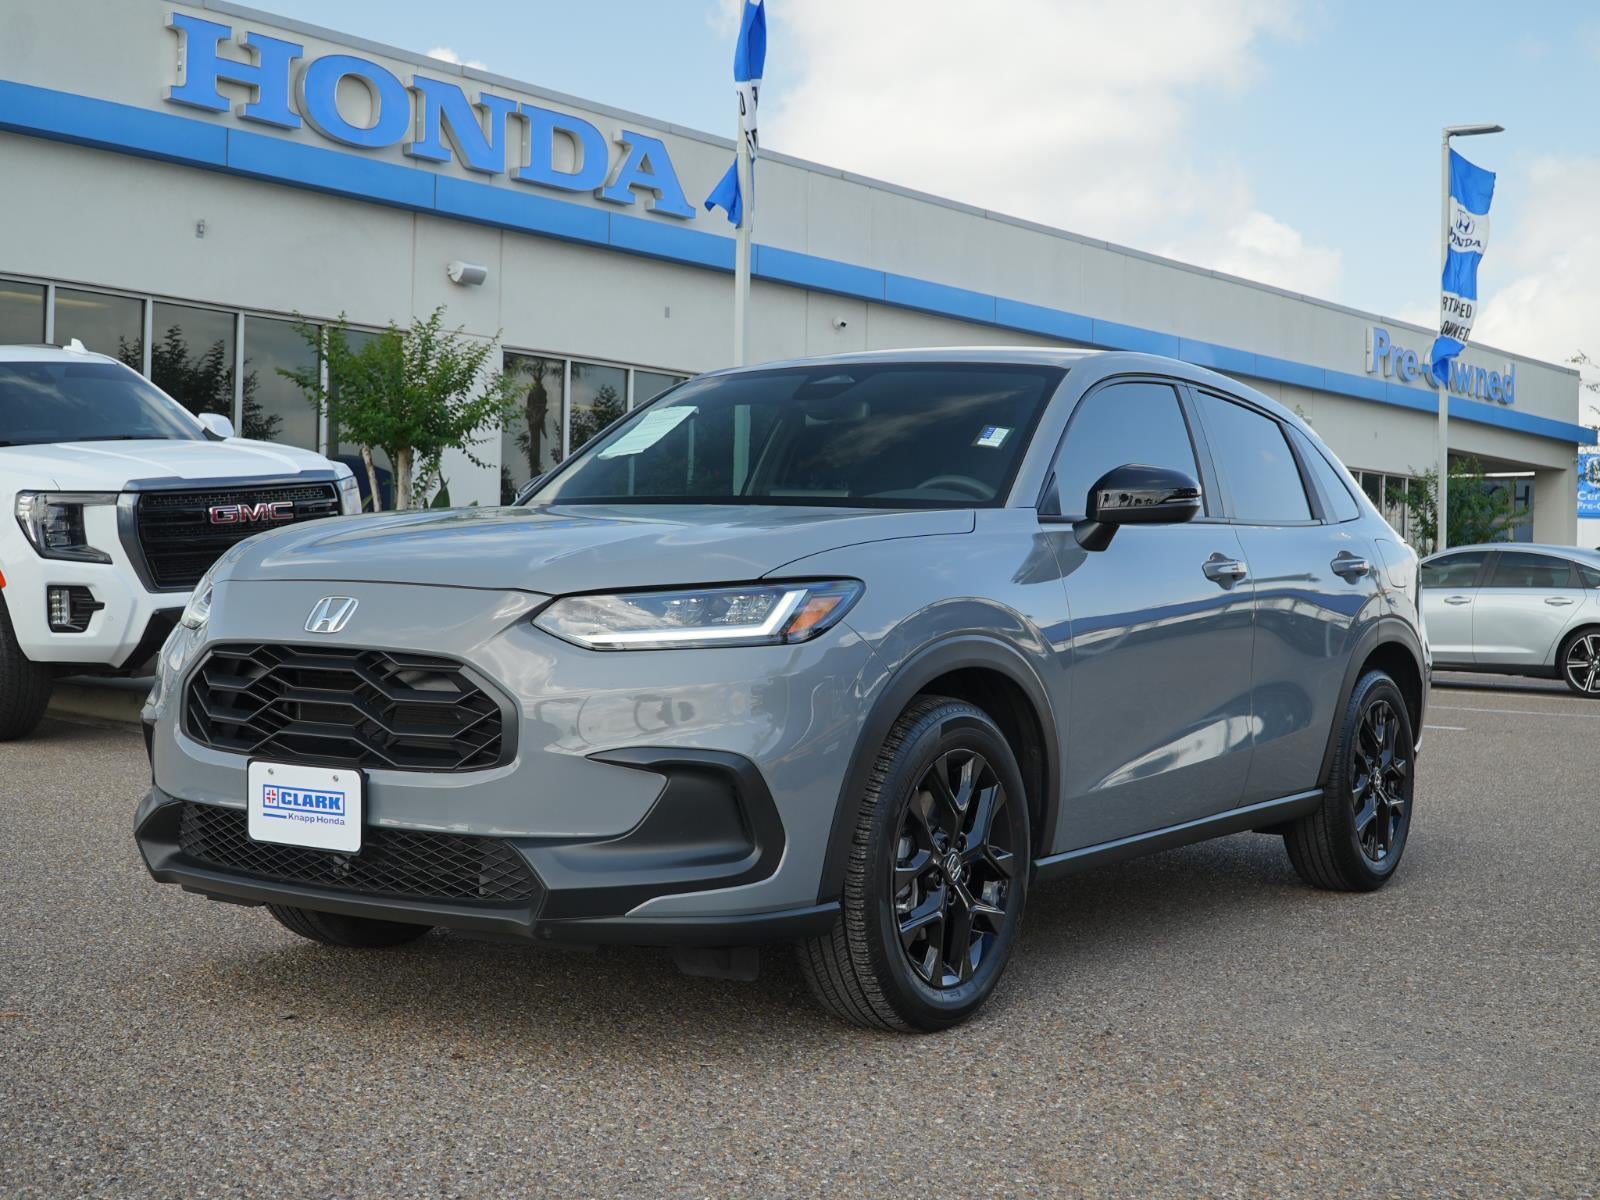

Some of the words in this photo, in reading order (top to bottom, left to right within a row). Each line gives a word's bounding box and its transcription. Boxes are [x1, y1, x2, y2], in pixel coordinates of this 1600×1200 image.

[164, 12, 699, 219] HONDA
[1366, 326, 1515, 404] Pre-wned
[209, 501, 294, 525] GMC
[281, 791, 341, 810] CLARK
[288, 812, 316, 824] Knapp
[316, 815, 346, 826] Honda
